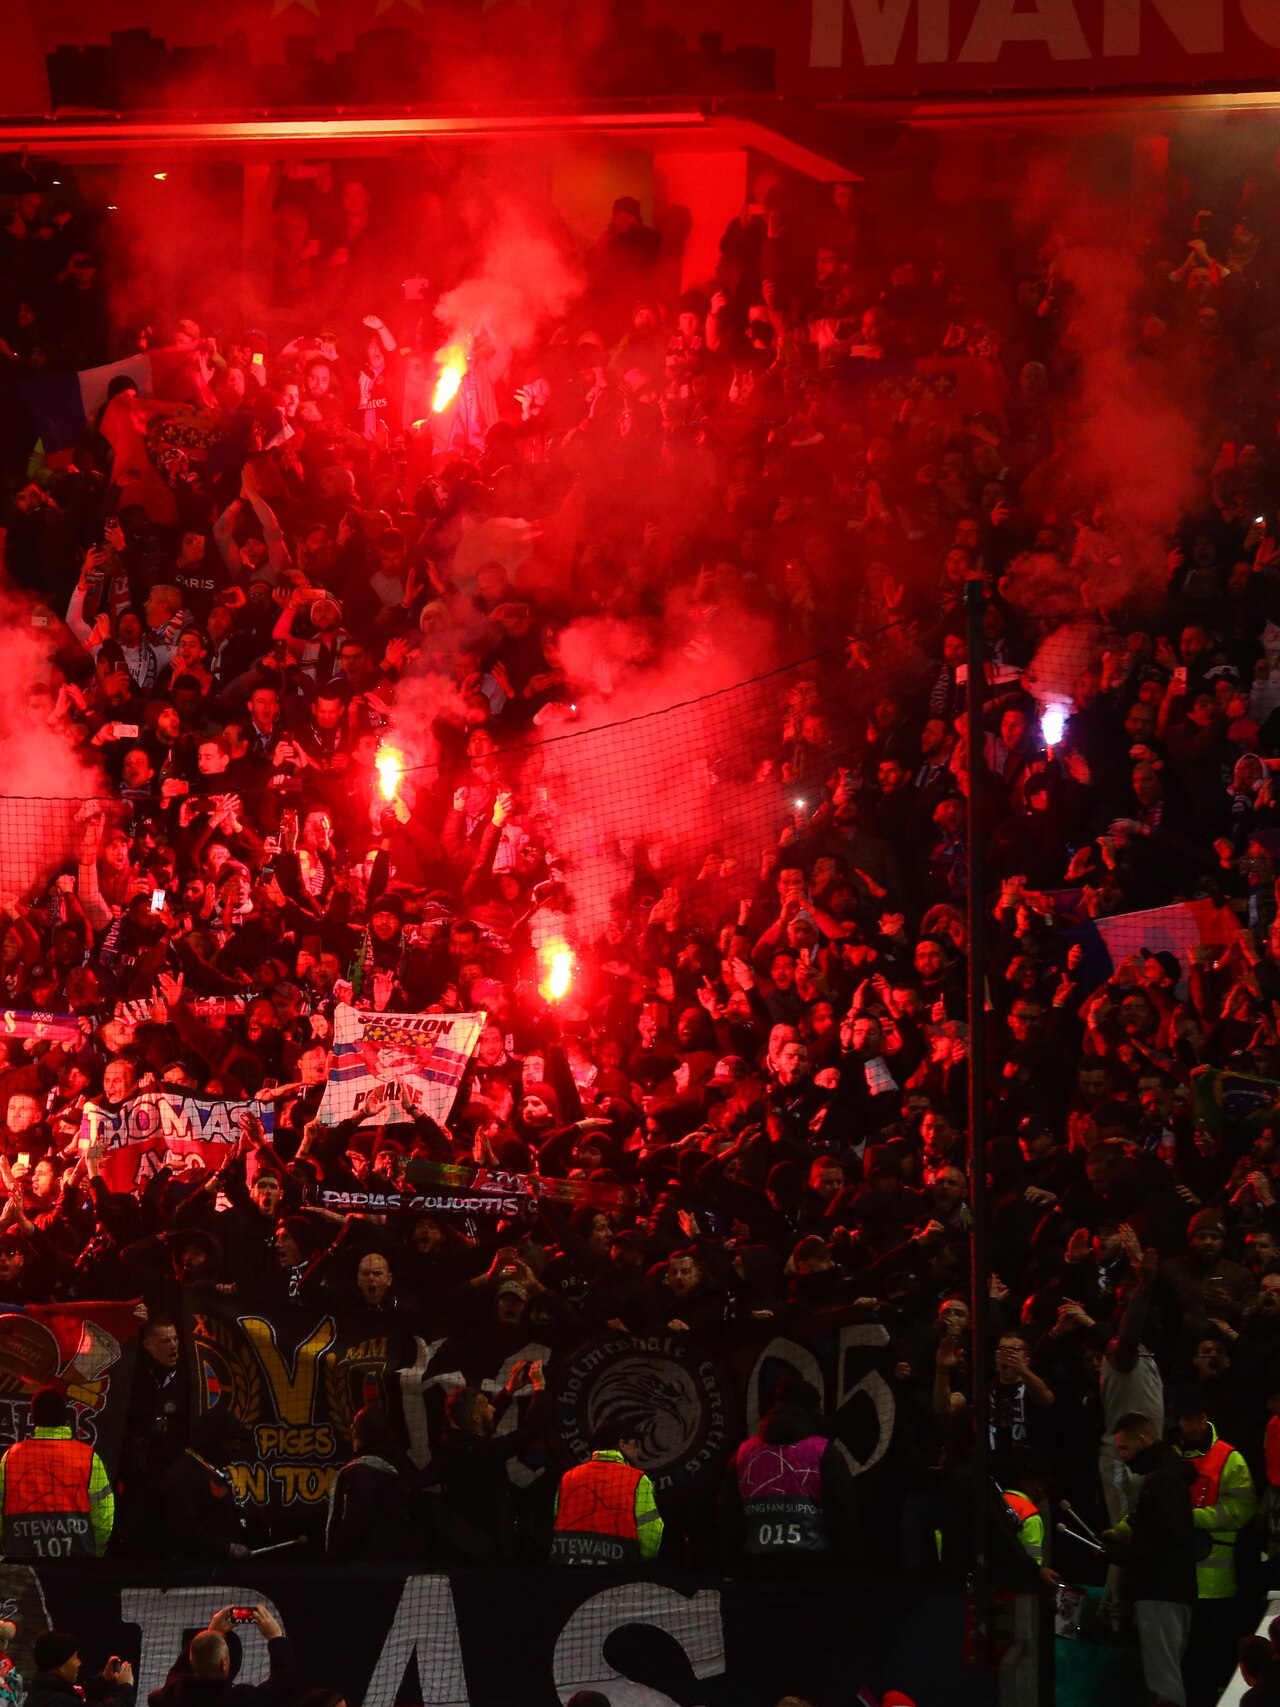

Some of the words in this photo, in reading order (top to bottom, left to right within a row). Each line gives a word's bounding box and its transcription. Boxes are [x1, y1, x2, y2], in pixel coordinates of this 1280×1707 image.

[358, 1014, 455, 1035] SECTION
[257, 1425, 336, 1458] PIGES
[13, 1518, 89, 1537] STEWARD
[759, 1523, 802, 1545] 015
[33, 1537, 73, 1558] 107
[550, 1537, 625, 1560] STEWARD
